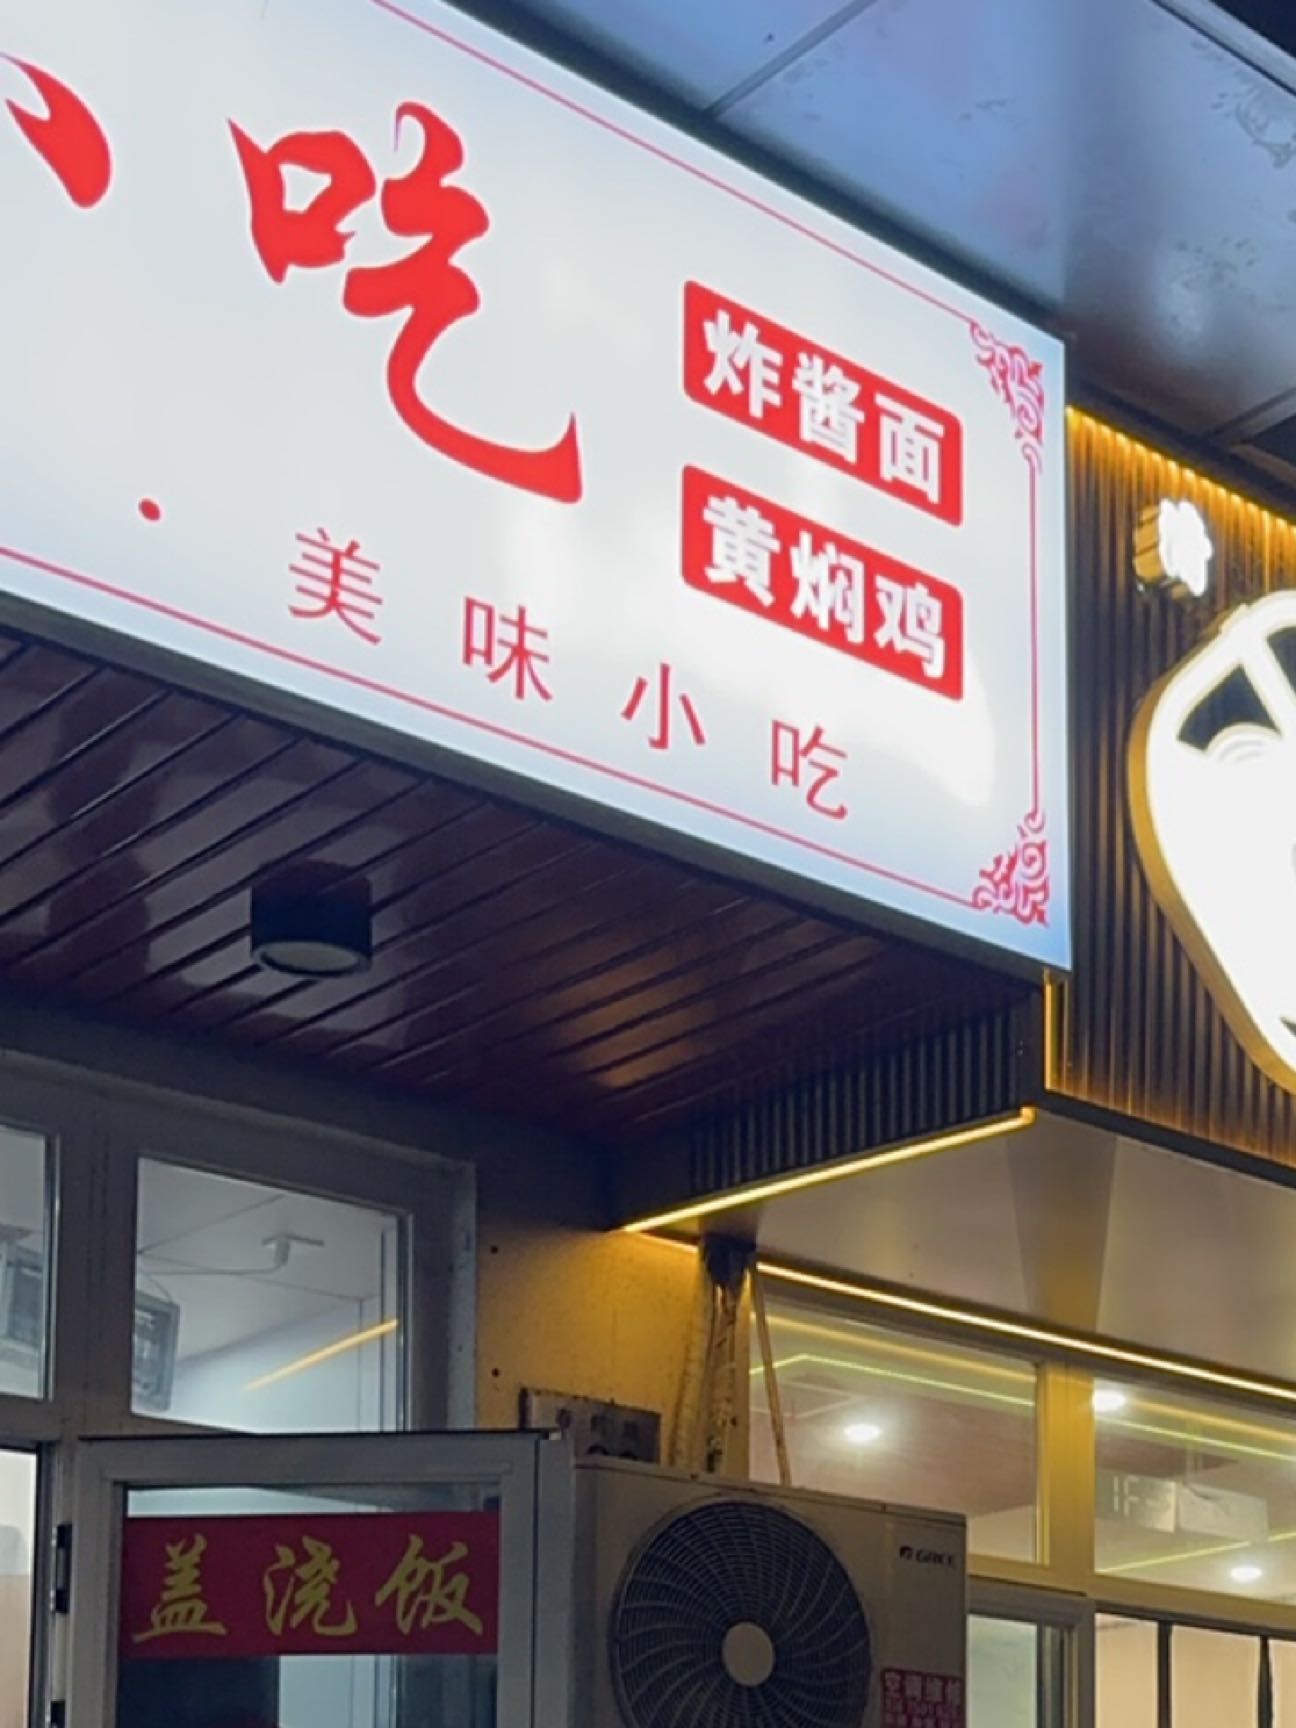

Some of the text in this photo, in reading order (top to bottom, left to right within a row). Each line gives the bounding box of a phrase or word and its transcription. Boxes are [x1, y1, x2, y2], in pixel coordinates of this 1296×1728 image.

[702, 310, 944, 503] 炸酱面
[288, 528, 849, 820] 美味小吃
[702, 494, 946, 679] 黄焖鸡
[132, 1535, 483, 1641] 盖浇饭
